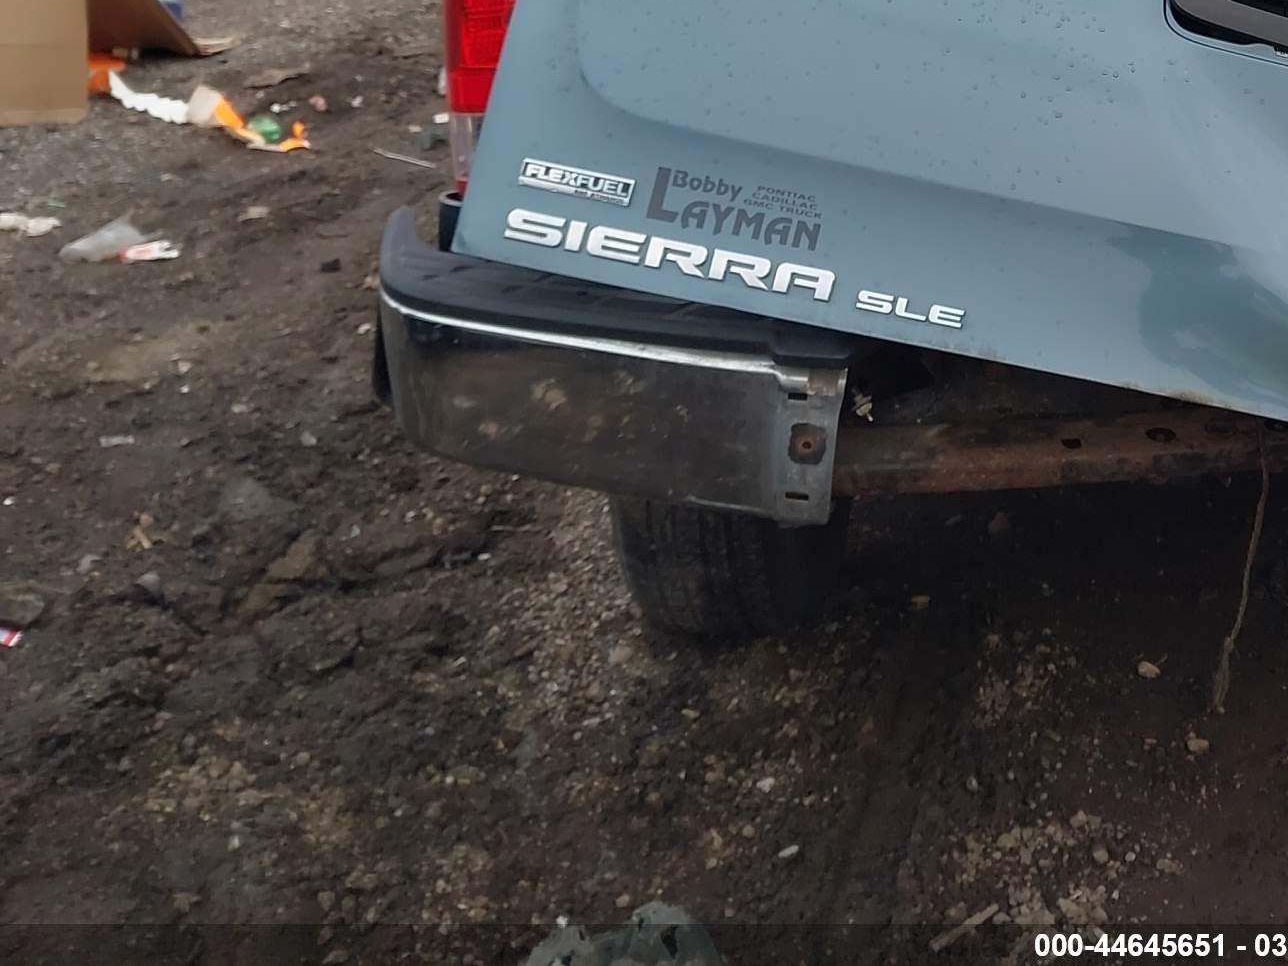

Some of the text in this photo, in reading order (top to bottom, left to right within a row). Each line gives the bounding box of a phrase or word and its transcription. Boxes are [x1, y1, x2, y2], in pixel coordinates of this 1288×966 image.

[525, 163, 628, 196] FLEXFUEL
[672, 169, 743, 202] Bobby
[757, 185, 817, 203] PONTIAC
[646, 166, 822, 251] LAYMAN
[743, 199, 823, 220] GMC TRUCK
[751, 192, 818, 211] CADILLAC
[503, 207, 966, 330] SIERRA SLE
